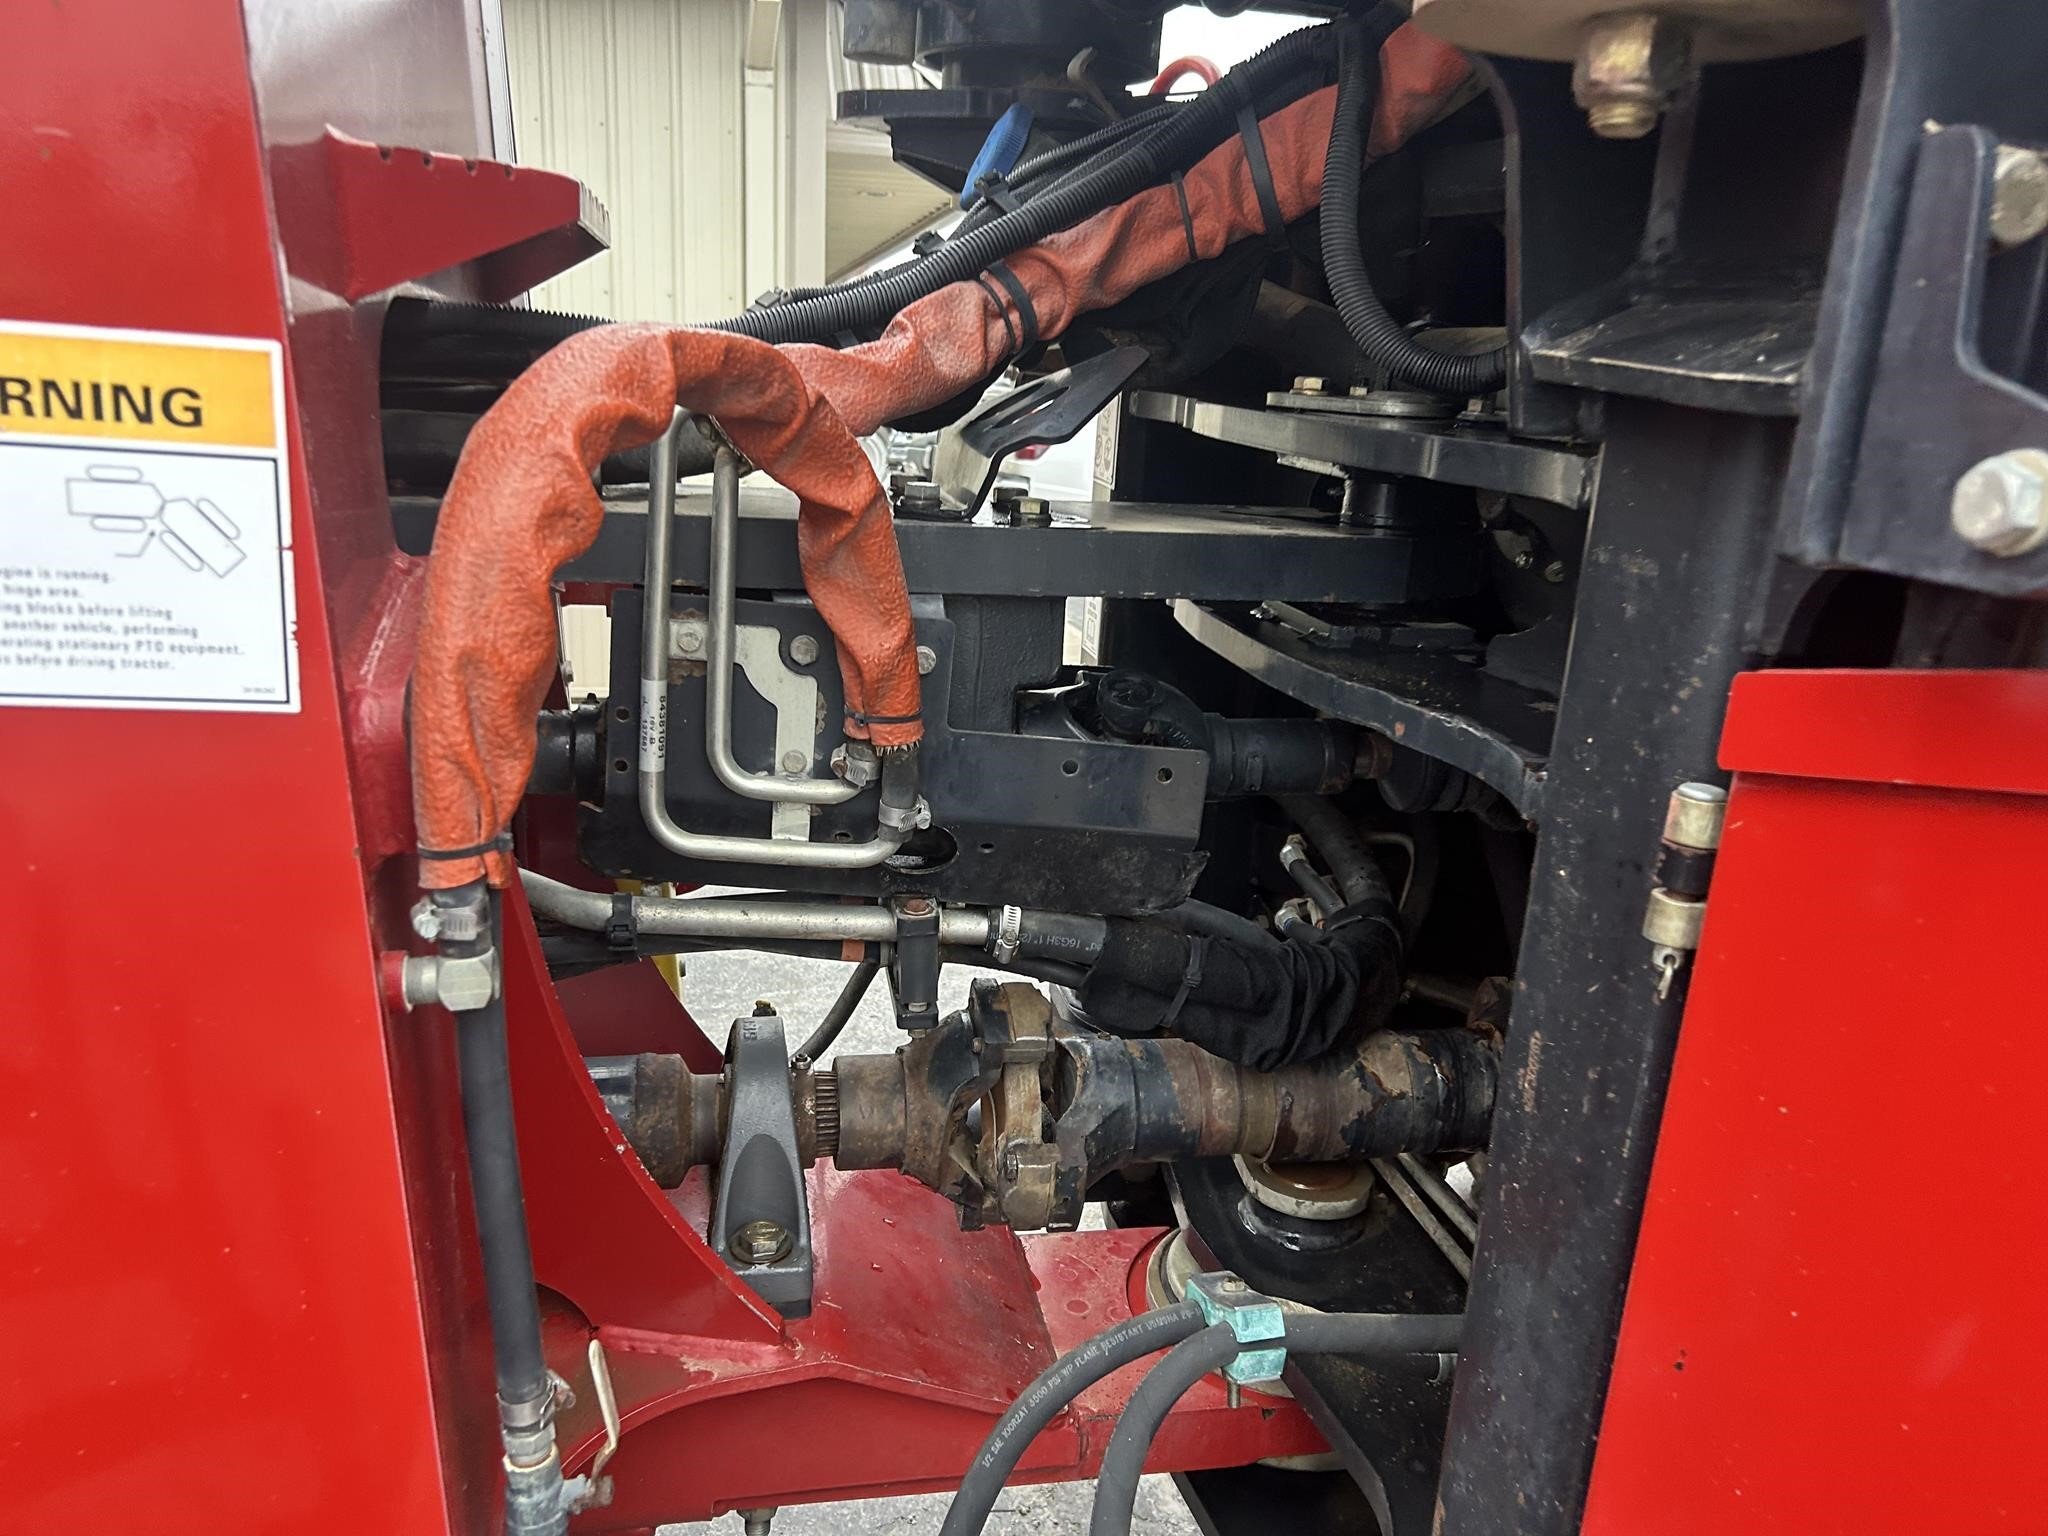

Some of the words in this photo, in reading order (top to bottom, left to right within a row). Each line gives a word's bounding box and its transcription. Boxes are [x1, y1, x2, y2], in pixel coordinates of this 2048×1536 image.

[0, 569, 32, 581] gine
[38, 569, 50, 579] is
[3, 583, 42, 599] hinge
[26, 601, 73, 616] blocks
[78, 602, 124, 617] before
[127, 604, 173, 621] lifting
[4, 619, 57, 631] another
[122, 624, 198, 640] performing
[57, 639, 129, 656] stationary
[135, 639, 165, 653] PTO
[15, 653, 61, 668] before
[67, 655, 116, 671] driving
[1073, 1344, 1101, 1369] FLAME
